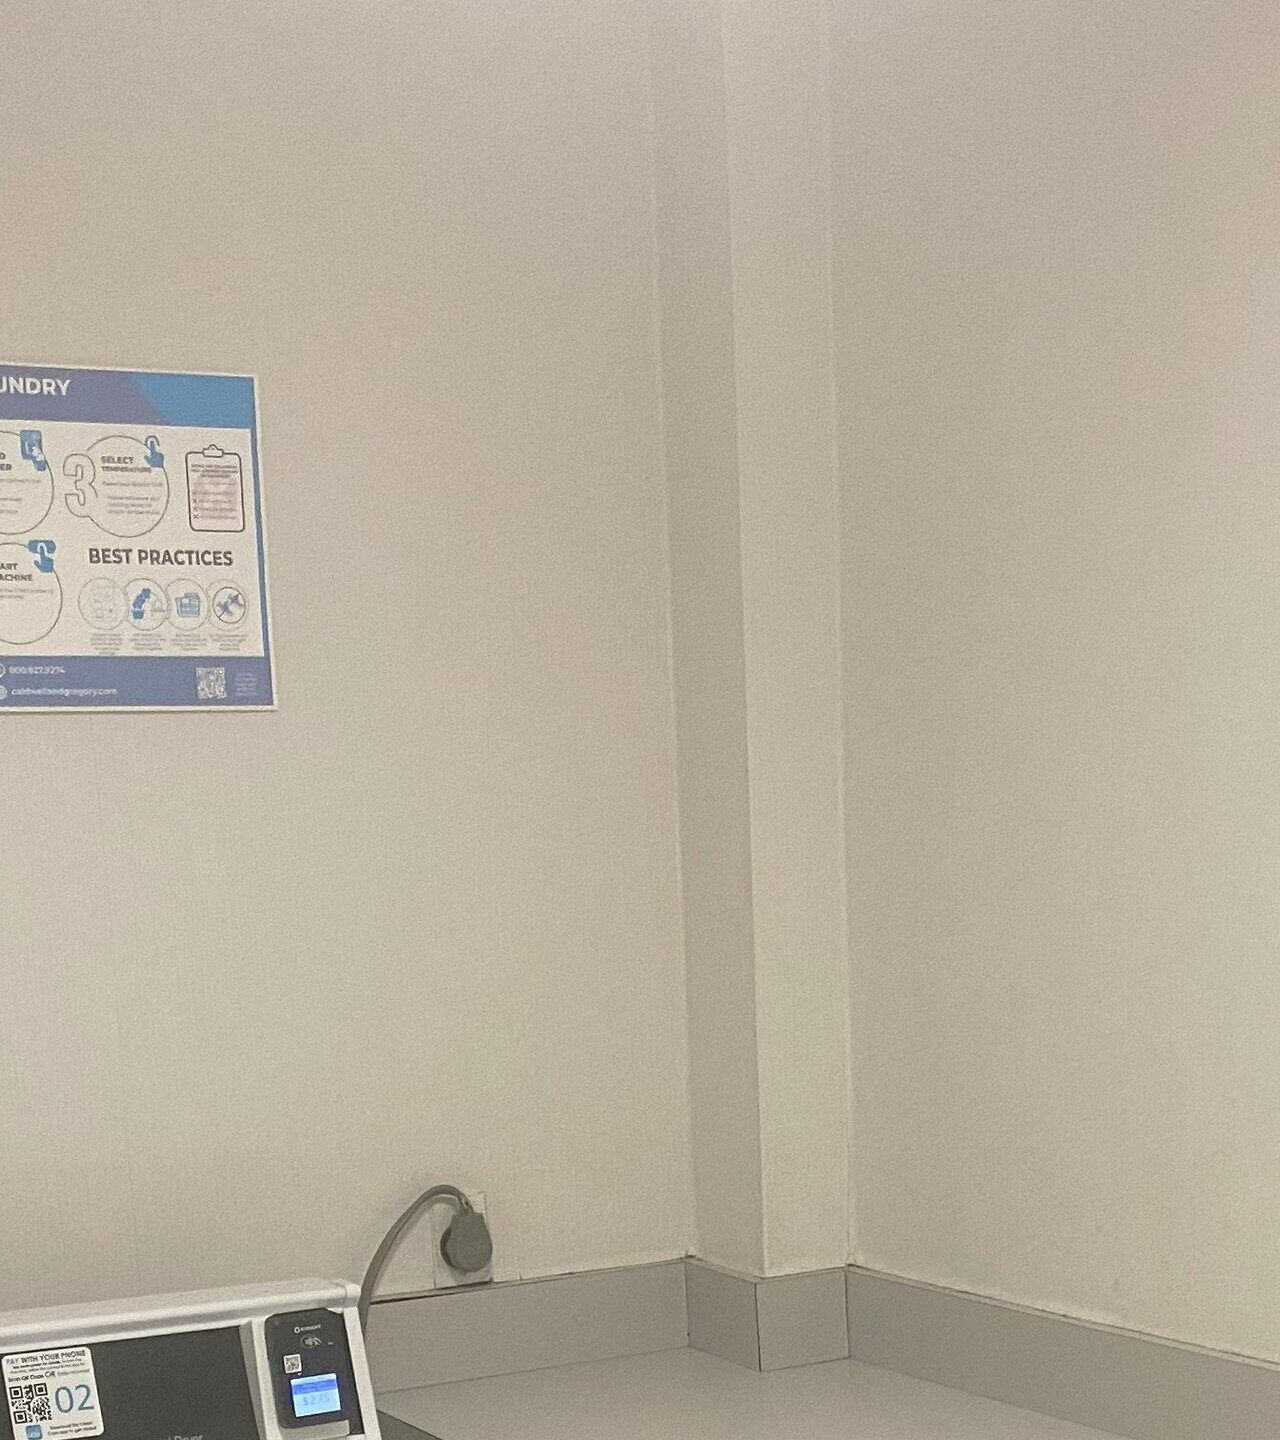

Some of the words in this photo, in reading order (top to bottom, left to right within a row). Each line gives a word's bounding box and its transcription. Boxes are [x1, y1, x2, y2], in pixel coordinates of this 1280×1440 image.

[100, 456, 134, 465] SELECT
[89, 547, 133, 565] BEST
[137, 549, 234, 566] PRACTICES
[39, 1352, 60, 1361] YOUR
[54, 1383, 95, 1413] 02
